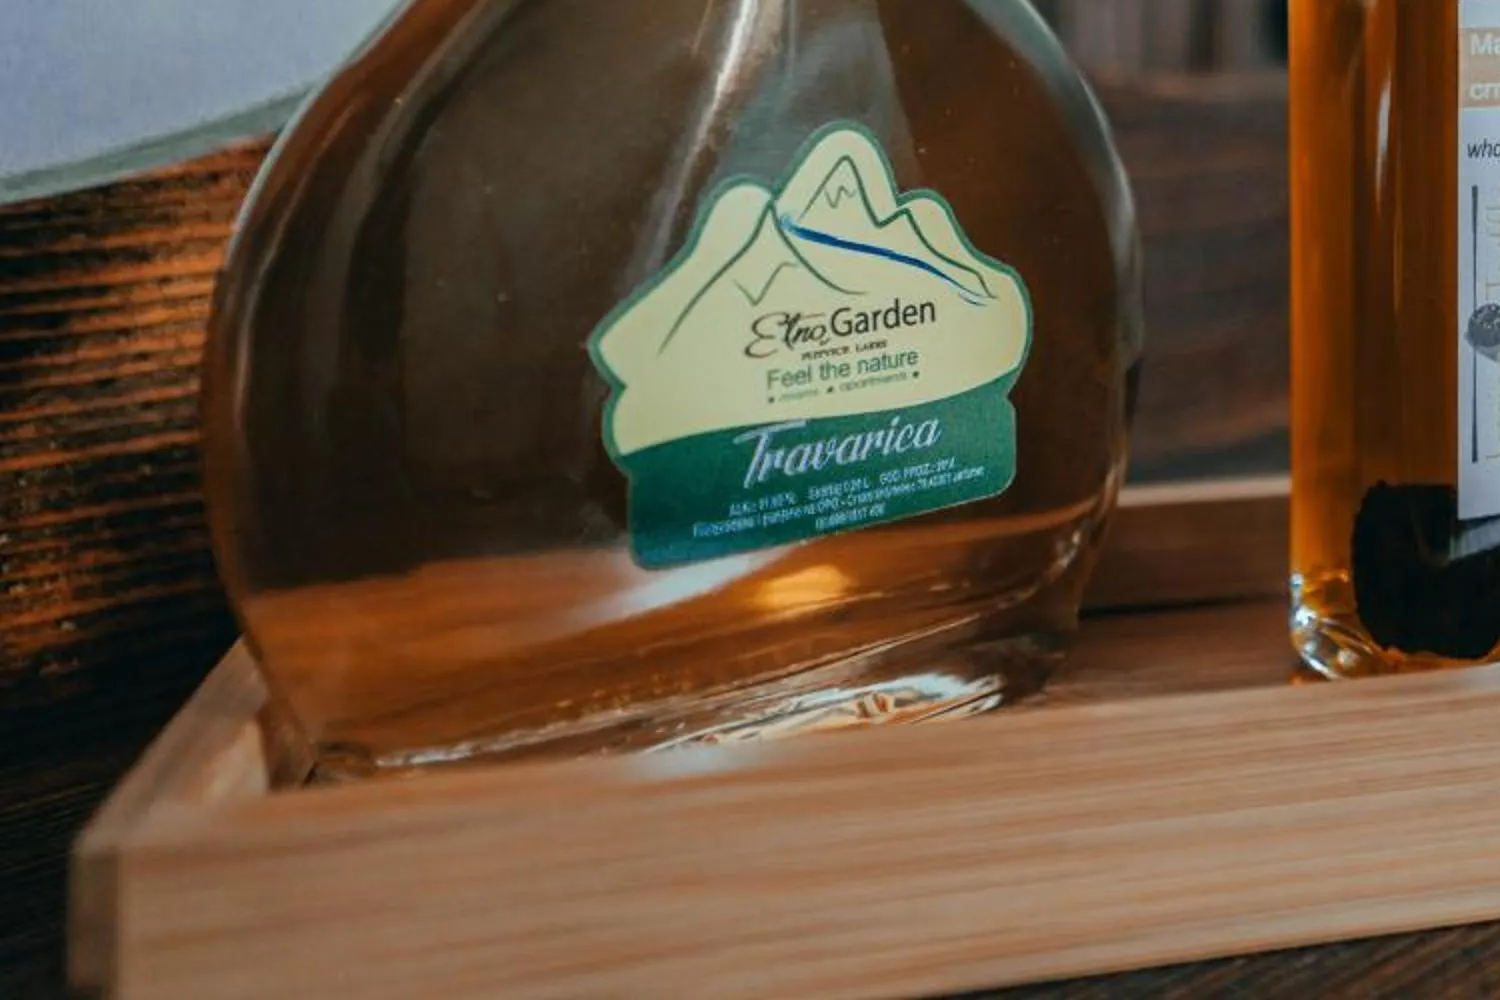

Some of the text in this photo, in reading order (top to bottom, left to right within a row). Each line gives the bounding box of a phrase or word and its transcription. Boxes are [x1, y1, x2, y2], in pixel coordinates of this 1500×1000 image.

[766, 349, 920, 390] Feel the nature
[733, 415, 943, 489] Travarica
